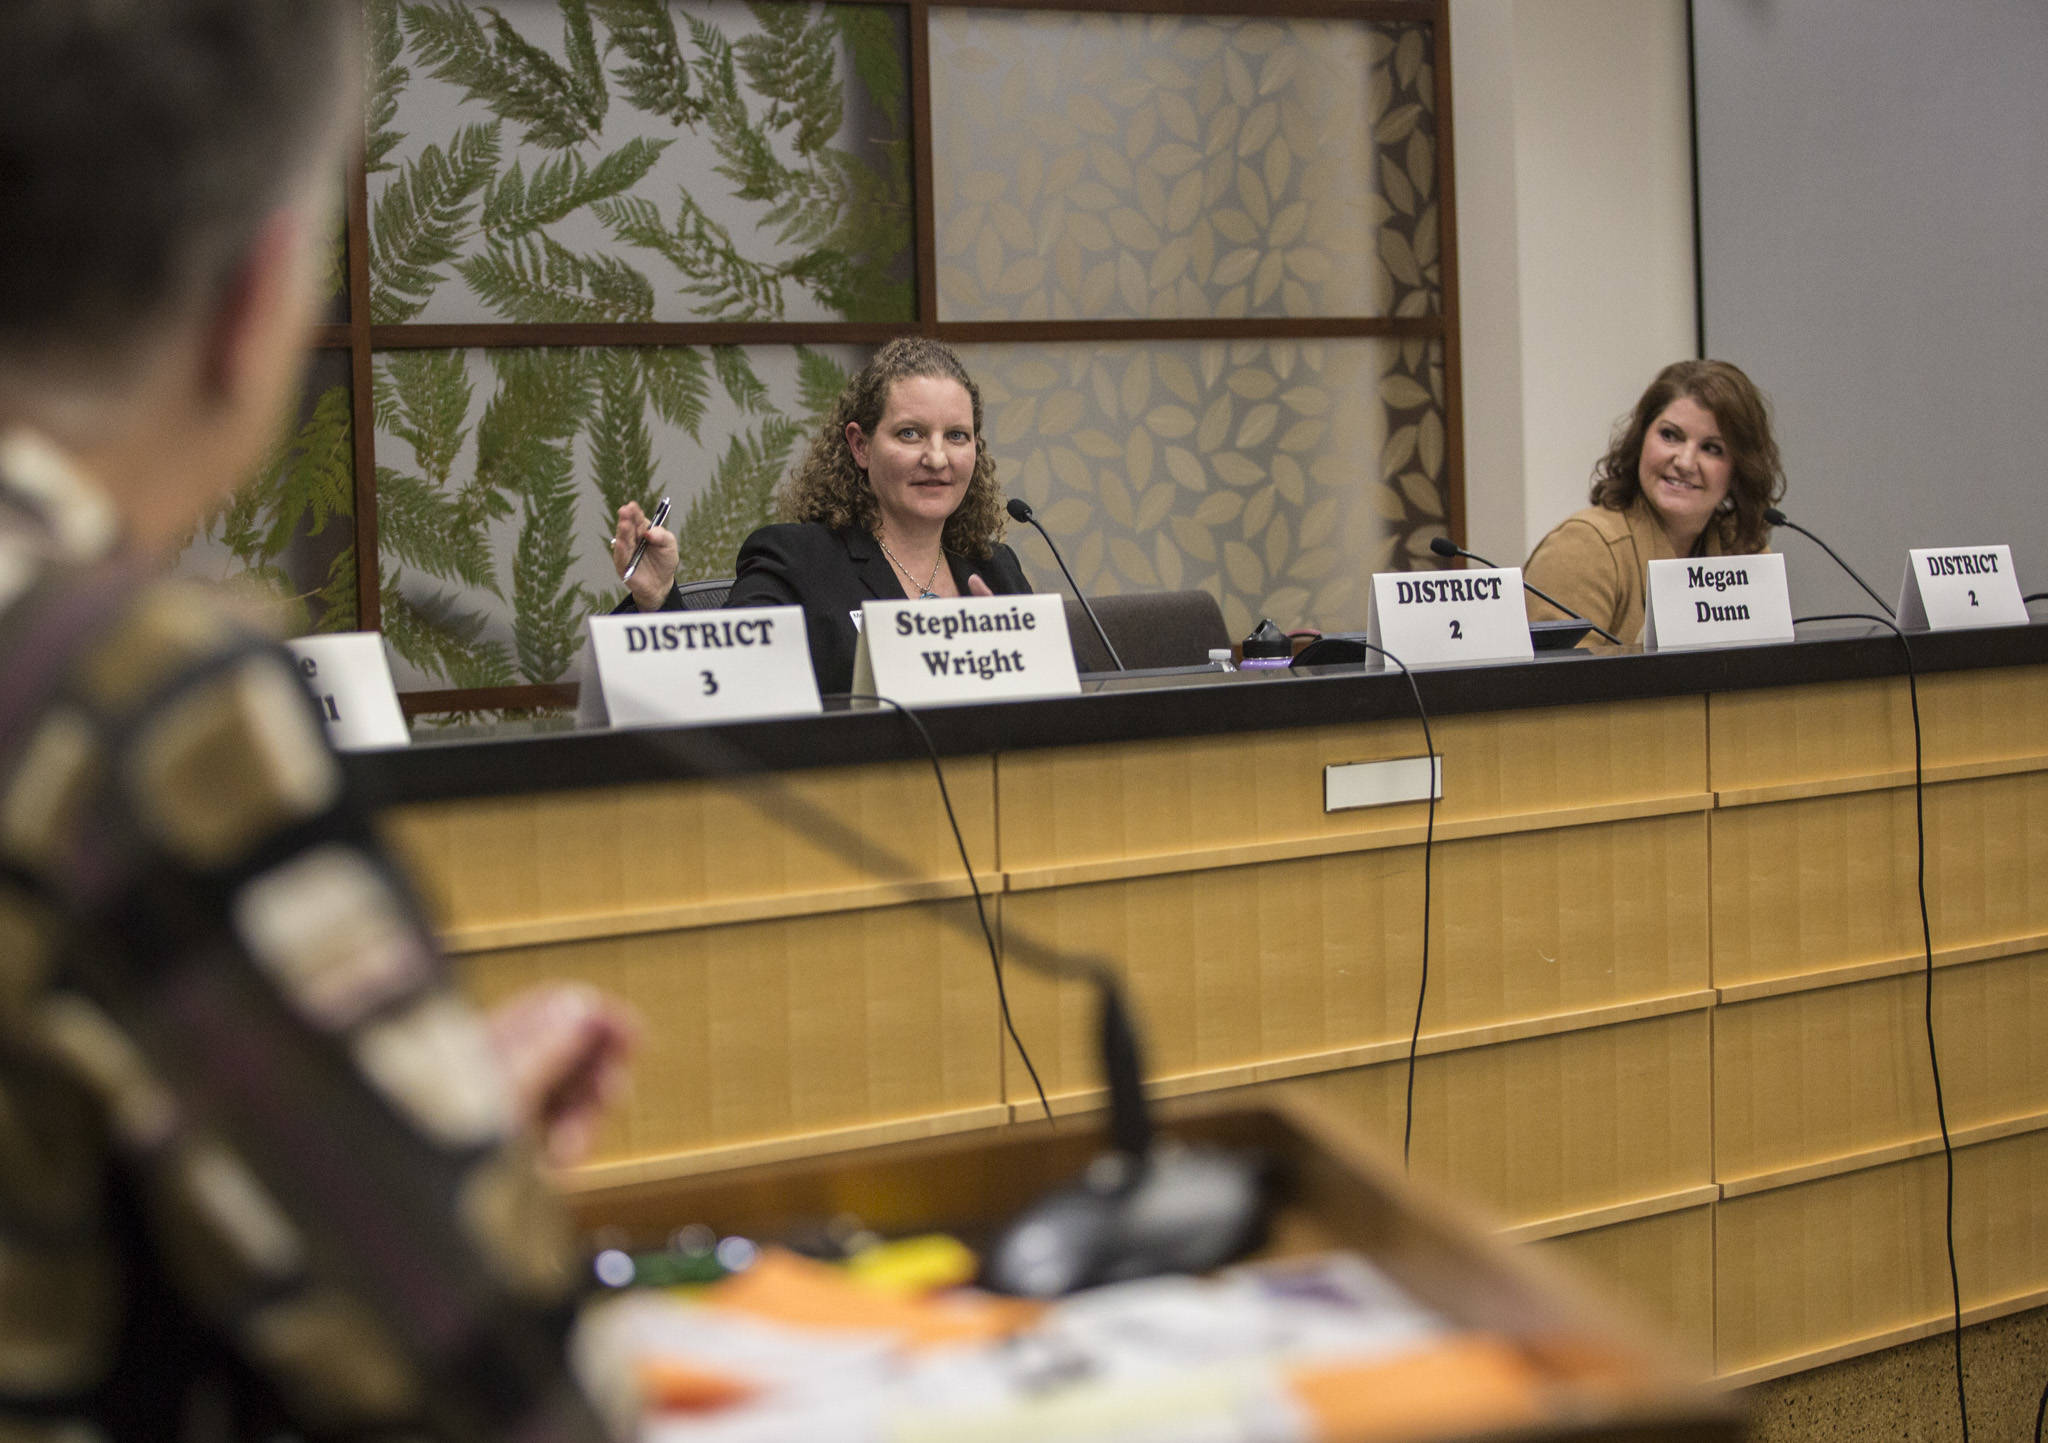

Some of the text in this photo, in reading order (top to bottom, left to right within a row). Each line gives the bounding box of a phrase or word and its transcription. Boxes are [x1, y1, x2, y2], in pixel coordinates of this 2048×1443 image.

[1926, 553, 1999, 577] DISTRICT
[1396, 577, 1502, 605] DISTRICT
[1687, 566, 1750, 593] Megan
[1694, 600, 1751, 623] Dunn
[1967, 589, 1979, 607] 2
[625, 619, 775, 653] DISTRICT
[895, 606, 1036, 640] Stephanie
[1449, 619, 1463, 640] 2
[921, 648, 1025, 680] Wright
[699, 670, 720, 697] 3
